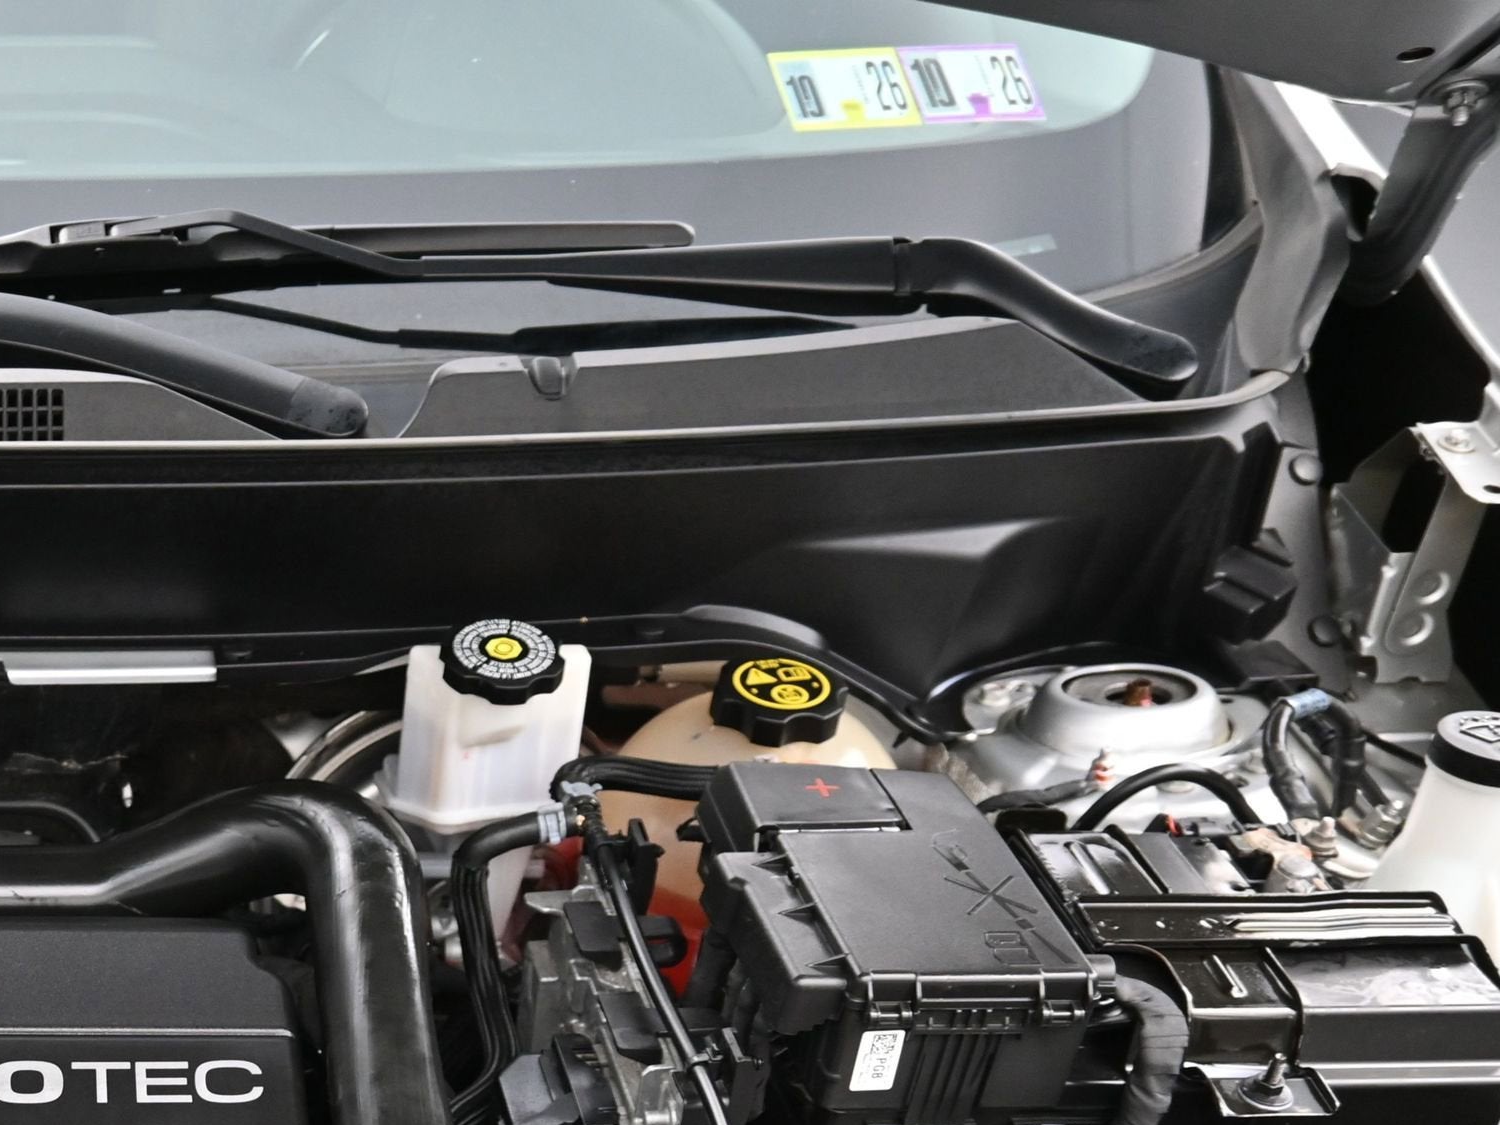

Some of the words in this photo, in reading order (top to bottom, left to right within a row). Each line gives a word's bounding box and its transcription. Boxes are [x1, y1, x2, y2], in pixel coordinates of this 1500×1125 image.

[865, 60, 908, 111] 26
[910, 57, 957, 108] 10
[989, 55, 1032, 105] 26
